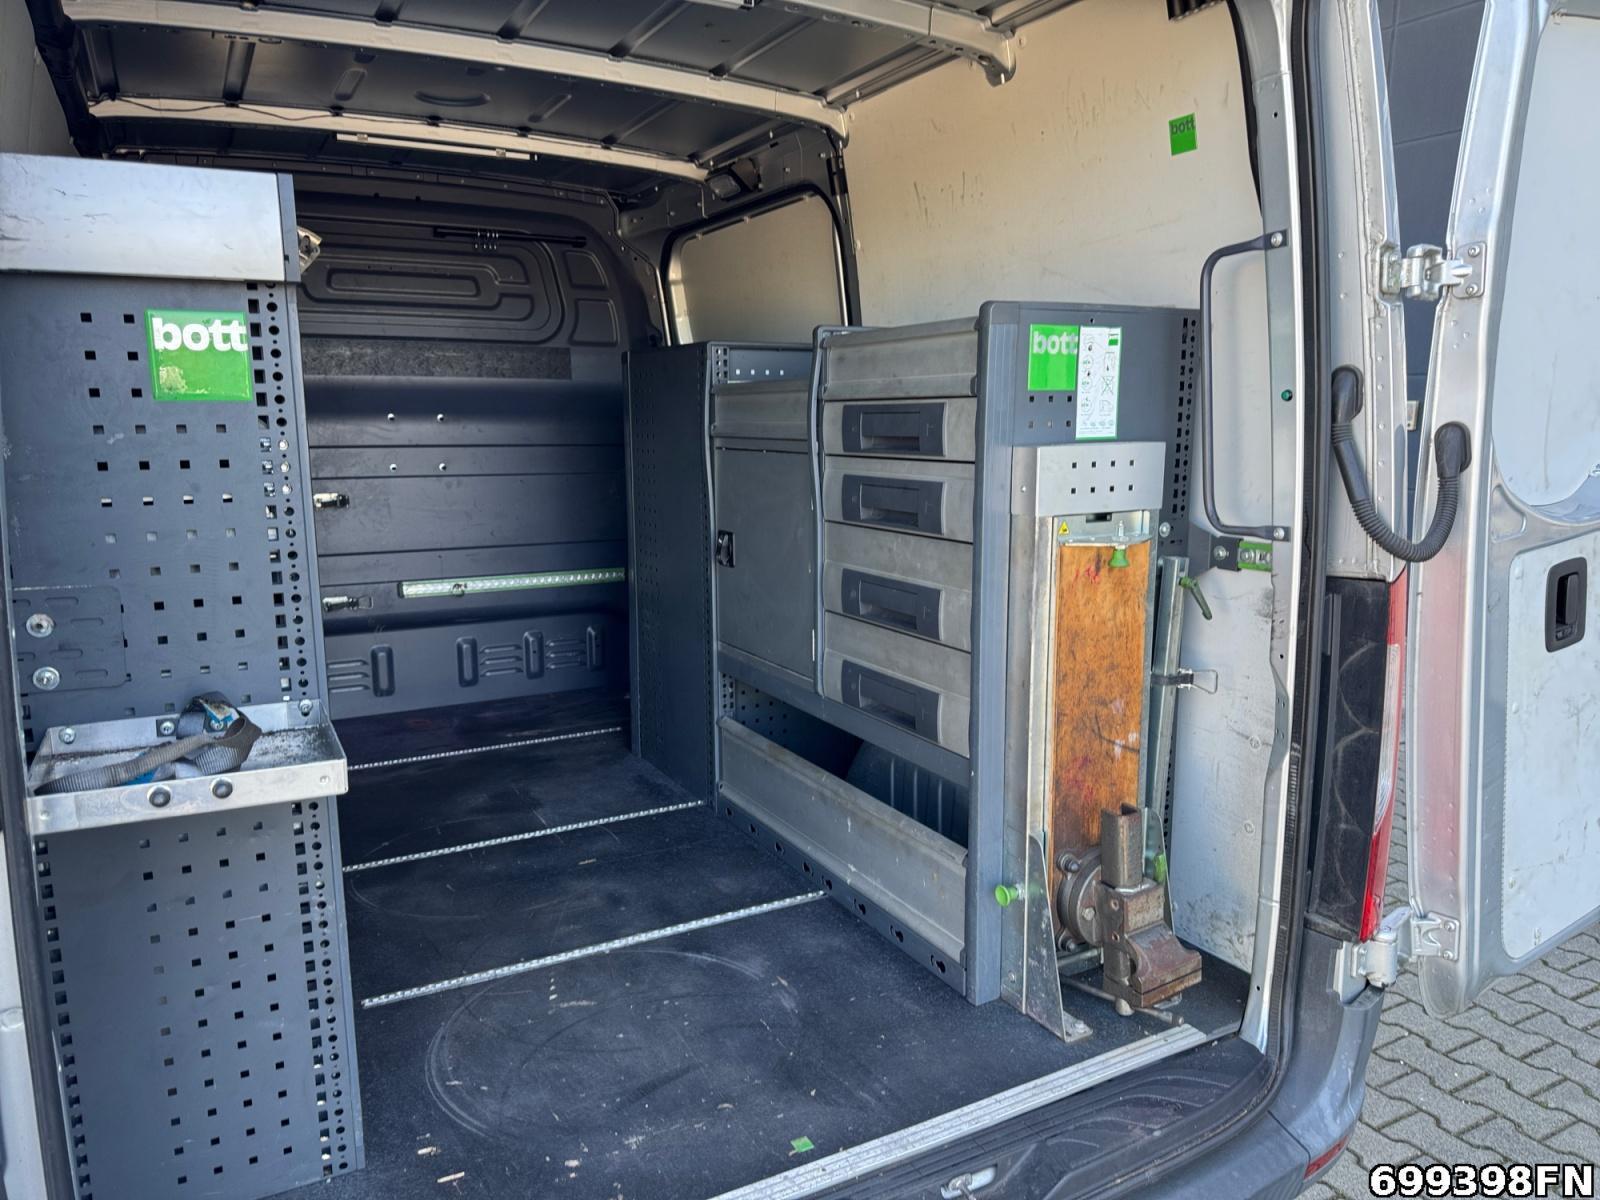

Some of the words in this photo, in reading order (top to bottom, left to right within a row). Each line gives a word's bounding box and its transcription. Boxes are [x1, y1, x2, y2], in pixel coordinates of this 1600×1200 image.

[1169, 117, 1195, 135] bott
[152, 318, 248, 352] bott
[1033, 331, 1078, 355] bott
